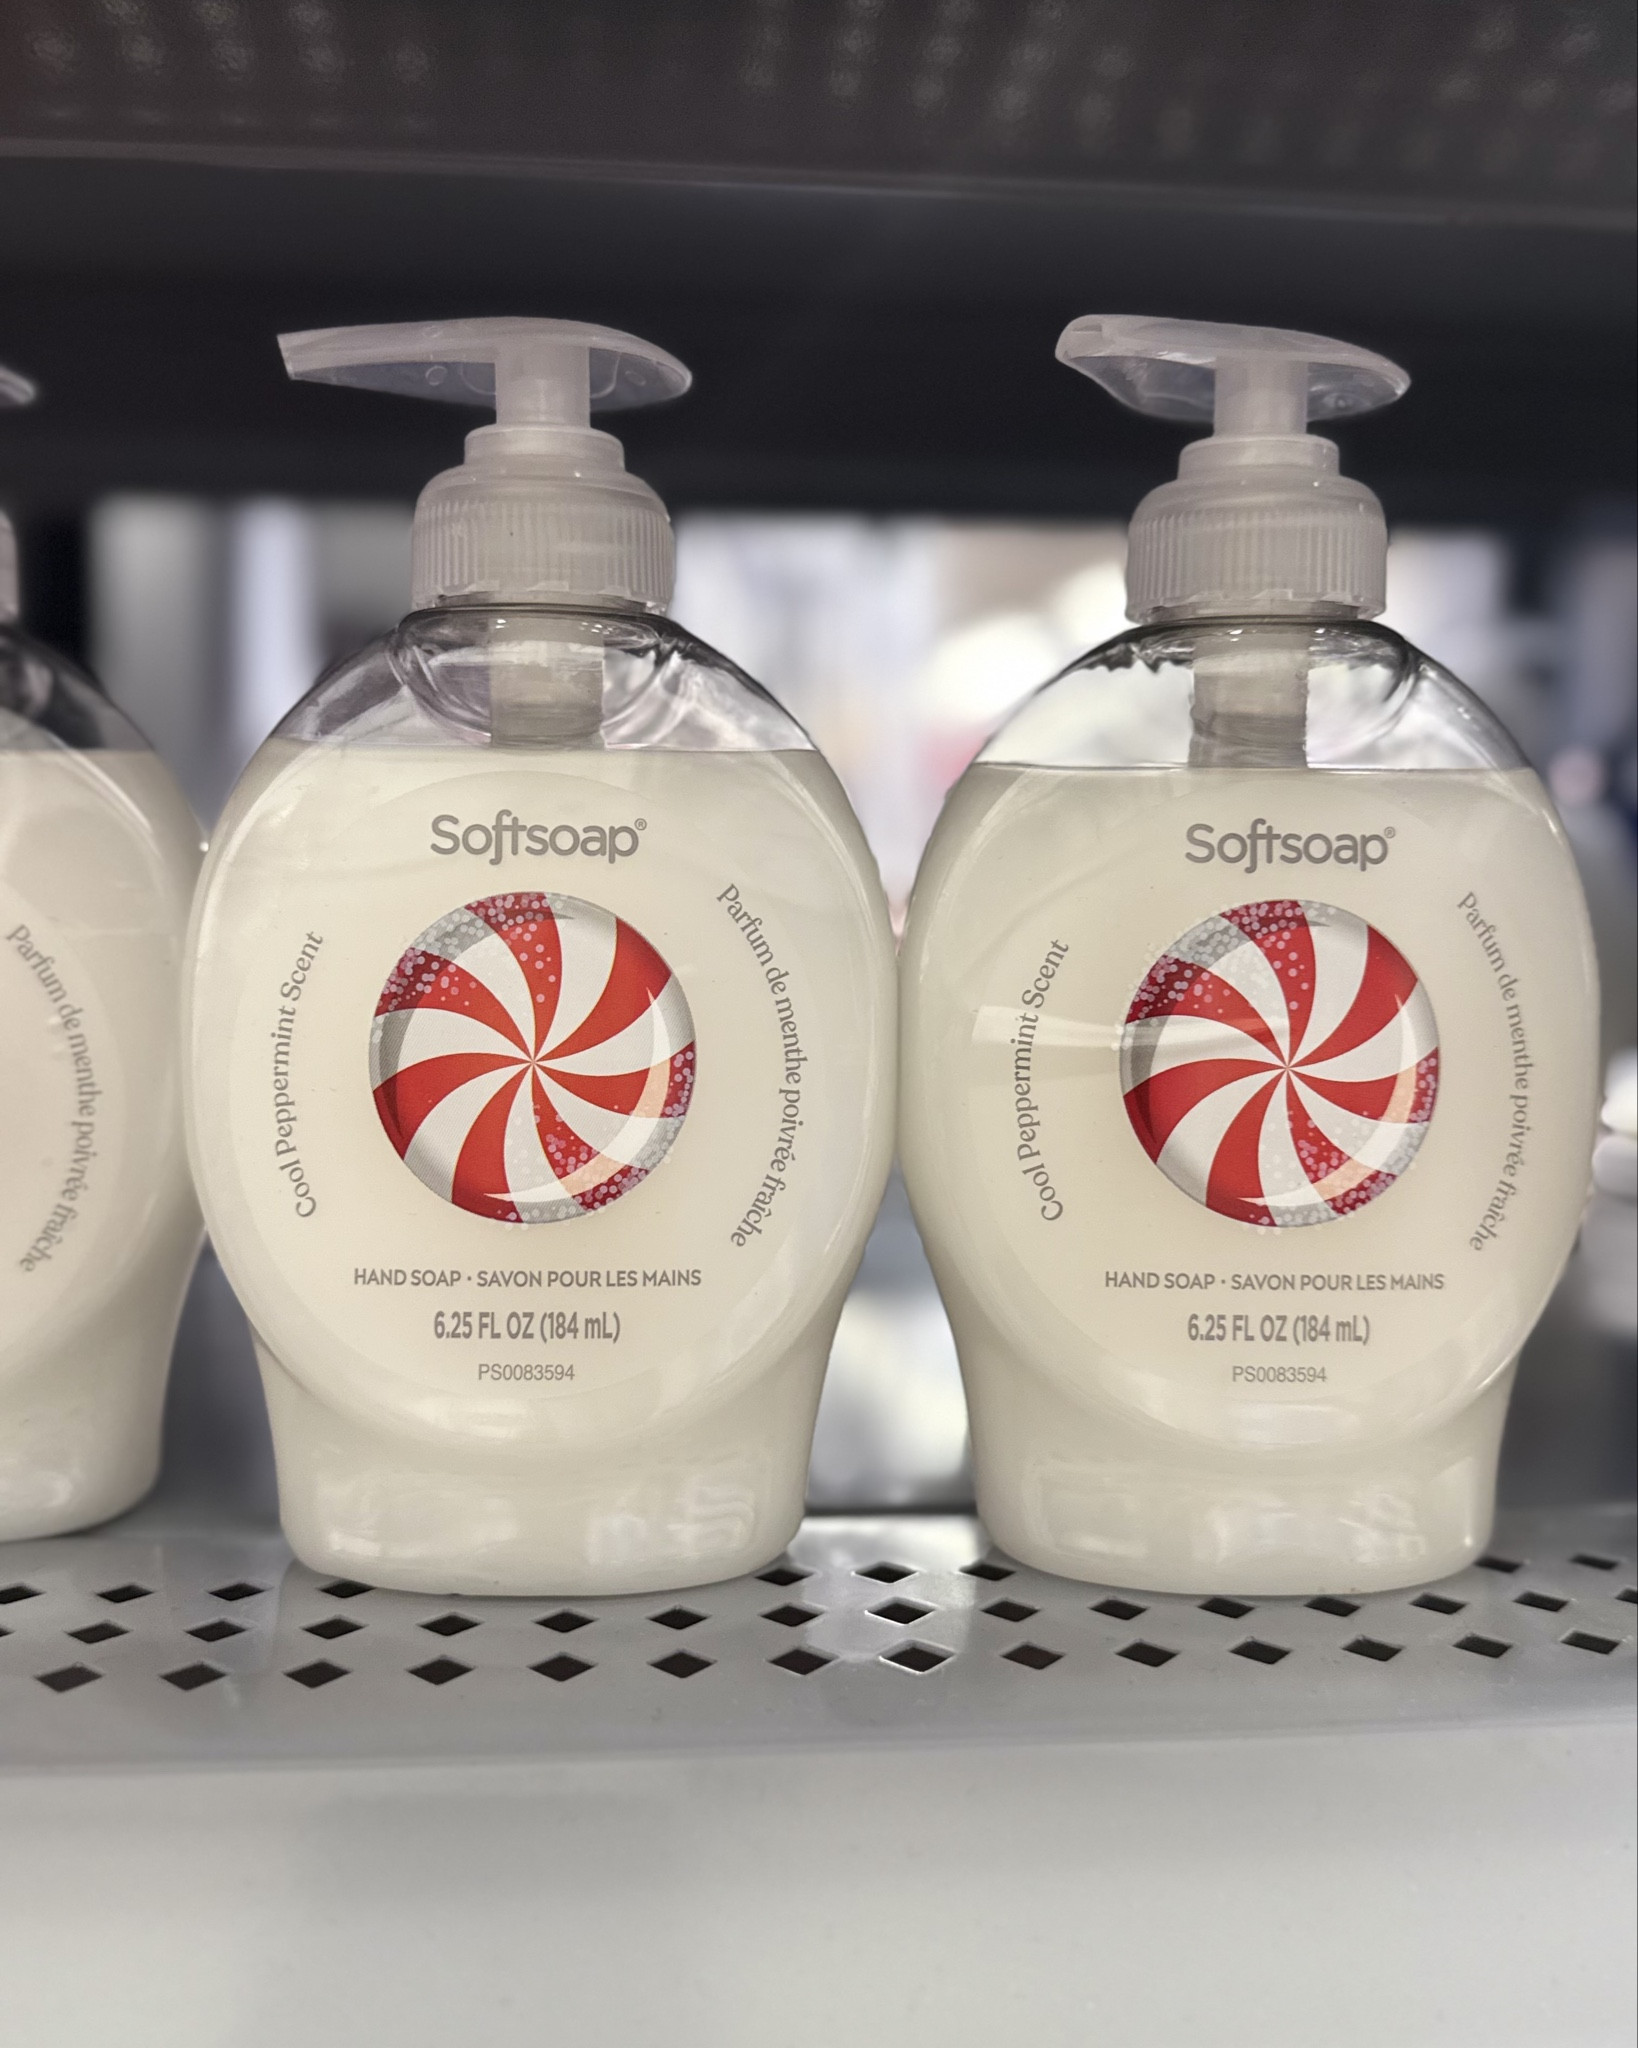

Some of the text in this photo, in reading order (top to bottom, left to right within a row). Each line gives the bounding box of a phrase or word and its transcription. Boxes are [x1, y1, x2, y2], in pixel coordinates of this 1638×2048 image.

[271, 931, 323, 1218] Cool Peppermint Scent
[716, 884, 807, 1248] Parfum de menthe poivrée fraîche
[1010, 939, 1069, 1222] Cool Peppermint Scent
[1457, 892, 1534, 1251] Parfum de menthe poivrée fraîche
[6, 924, 102, 1272] Parfum de menthe poivrée fraîche
[354, 1268, 702, 1287] HAND SOAP SAVON POUR LES MAINS
[1105, 1271, 1444, 1291] HAND SOAP SAVON POUR LES MAINS
[434, 1311, 620, 1342] 6.25 FL OZ (184 mL)
[1188, 1313, 1371, 1345] 6.25 FL OZ (184 mL)
[478, 1363, 575, 1381] PS0083594
[1232, 1366, 1327, 1383] PS0083594
